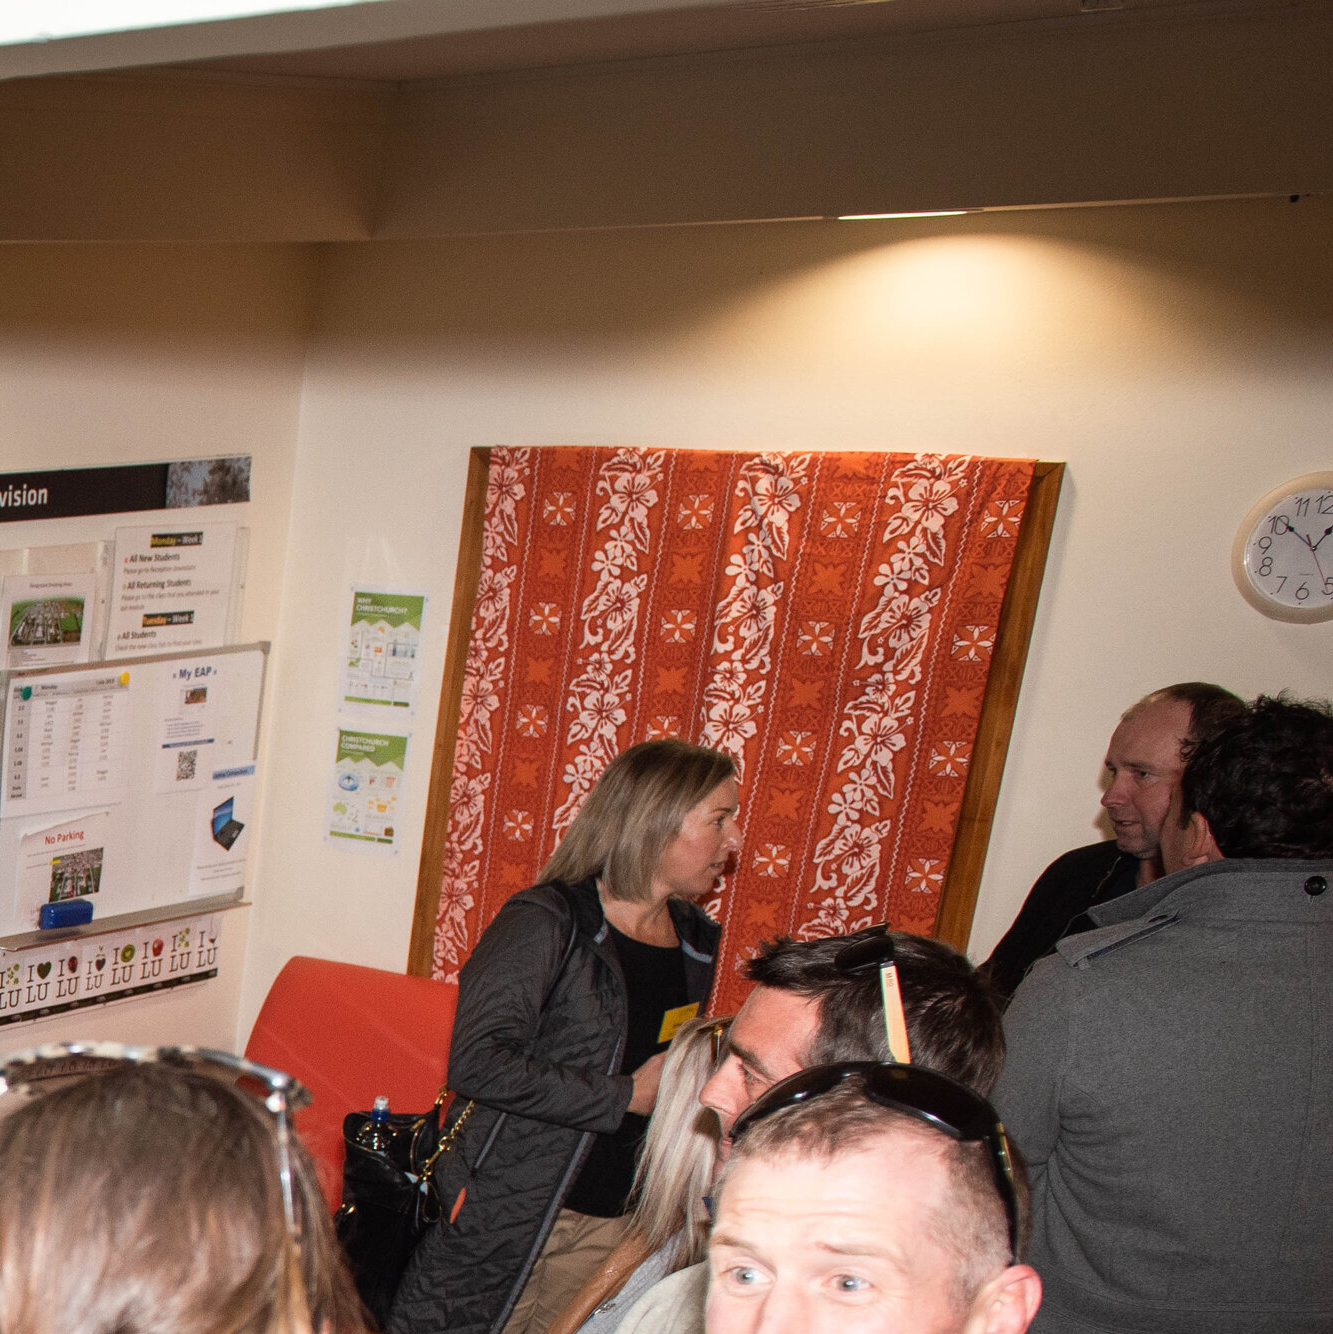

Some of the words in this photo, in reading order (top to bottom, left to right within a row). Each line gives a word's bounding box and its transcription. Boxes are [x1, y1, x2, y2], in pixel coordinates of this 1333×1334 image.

[1295, 498, 1310, 517] 11
[1316, 495, 1333, 514] 12
[1268, 515, 1289, 535] 10
[1259, 536, 1272, 554] 9
[1259, 557, 1273, 576] 8
[136, 581, 165, 589] Returning
[1276, 576, 1287, 593] 7
[1296, 582, 1310, 600] 6
[1322, 577, 1333, 595] 5
[131, 631, 156, 639] Students
[179, 669, 191, 680] My
[194, 666, 212, 677] EAP
[45, 836, 54, 844] No
[57, 831, 84, 841] Parking
[172, 935, 179, 951] I
[200, 931, 206, 948] I
[113, 948, 120, 964] I
[142, 942, 150, 959] I
[196, 947, 218, 968] LU
[58, 959, 66, 977] I
[87, 961, 93, 974] I
[140, 959, 164, 979] LU
[169, 952, 192, 972] LU
[27, 965, 34, 983] I
[86, 974, 105, 990] LU
[110, 965, 134, 985] LU
[26, 983, 51, 1003] LU
[56, 977, 80, 998] LU
